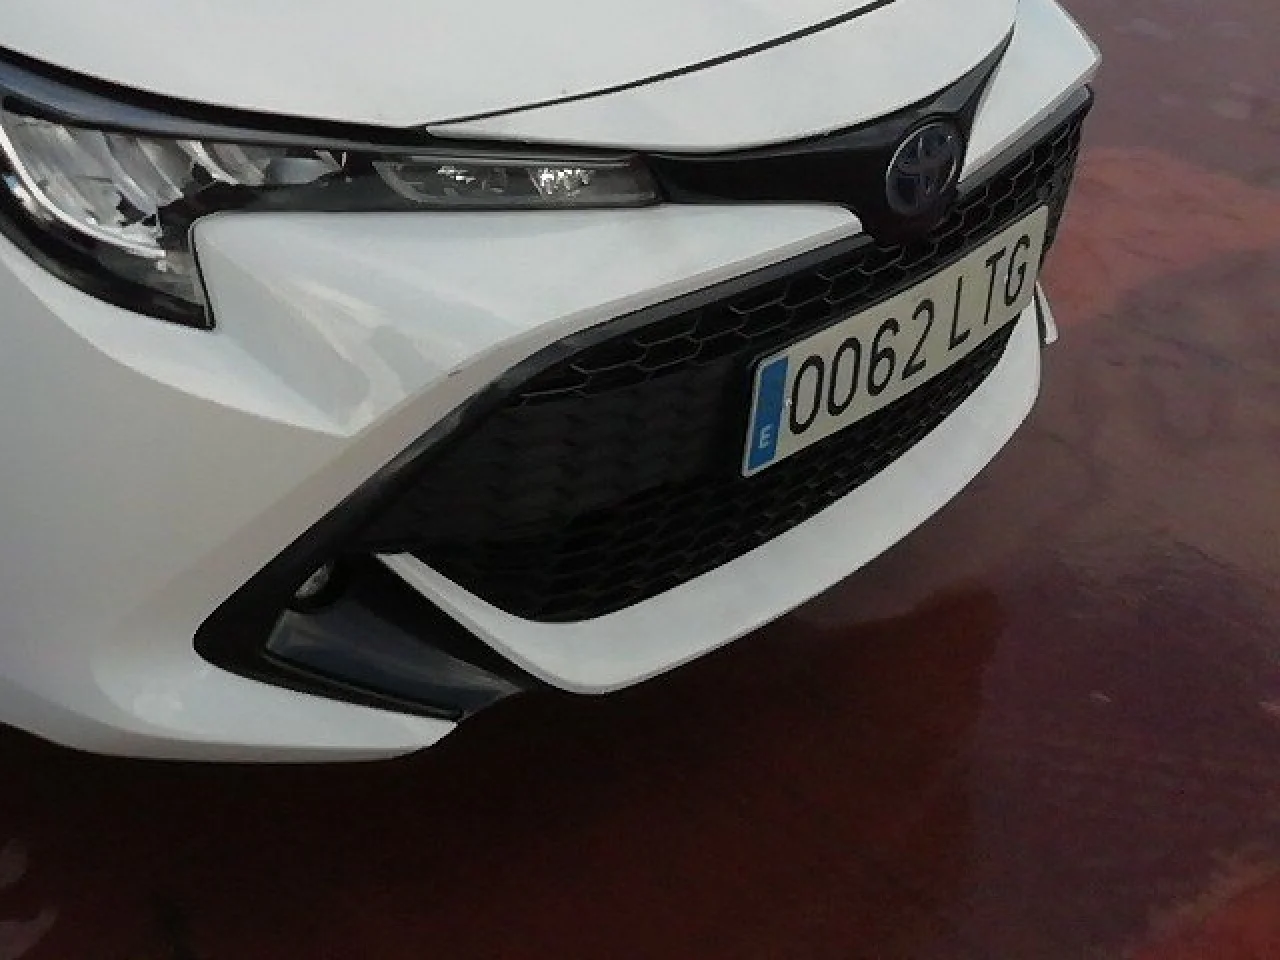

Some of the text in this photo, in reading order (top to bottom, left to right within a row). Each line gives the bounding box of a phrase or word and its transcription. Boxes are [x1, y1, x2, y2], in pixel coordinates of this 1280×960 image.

[789, 234, 1031, 435] 0062 LTG
[758, 423, 772, 450] E
